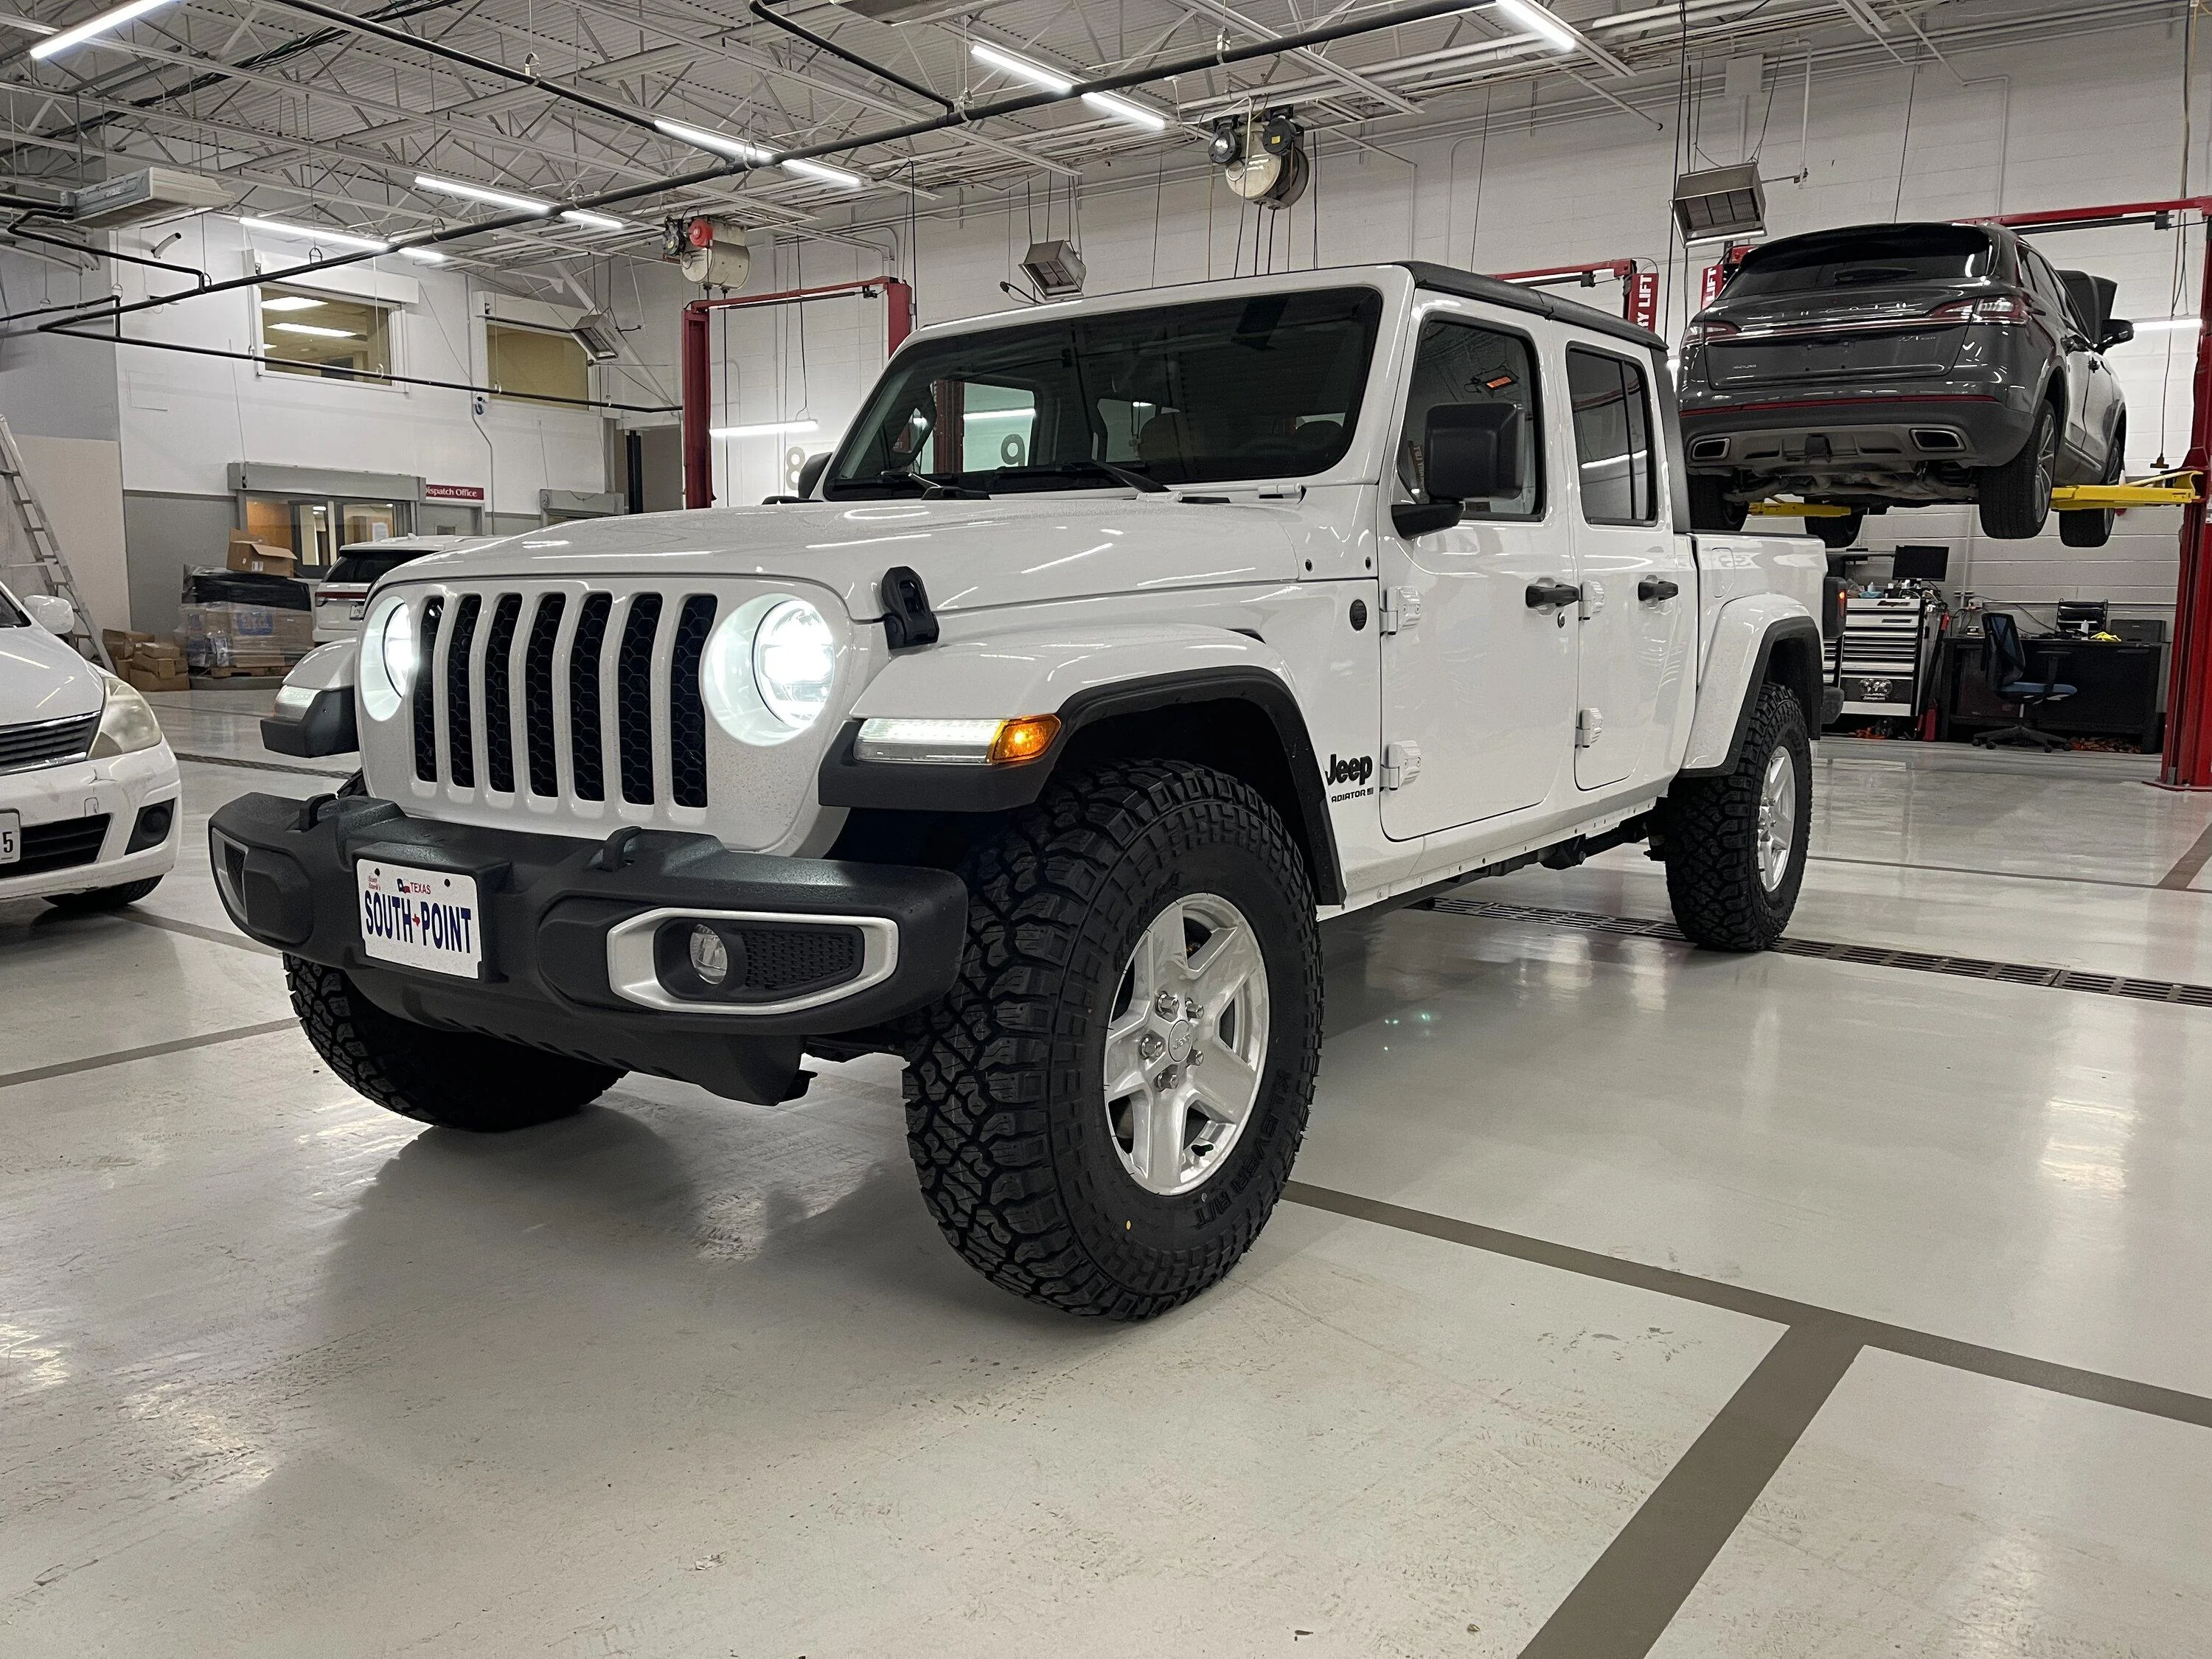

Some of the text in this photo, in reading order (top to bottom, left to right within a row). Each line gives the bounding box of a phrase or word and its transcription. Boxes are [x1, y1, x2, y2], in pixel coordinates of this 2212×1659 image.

[1638, 275, 1652, 307] LIFT
[1706, 268, 1717, 302] LIFT
[1001, 434, 1026, 467] 9
[786, 446, 806, 491] 8
[456, 488, 477, 497] Office
[1325, 754, 1373, 786] Jeep
[2, 831, 13, 853] 5
[410, 881, 431, 895] TEXAS
[364, 889, 471, 954] SOUTH POINT
